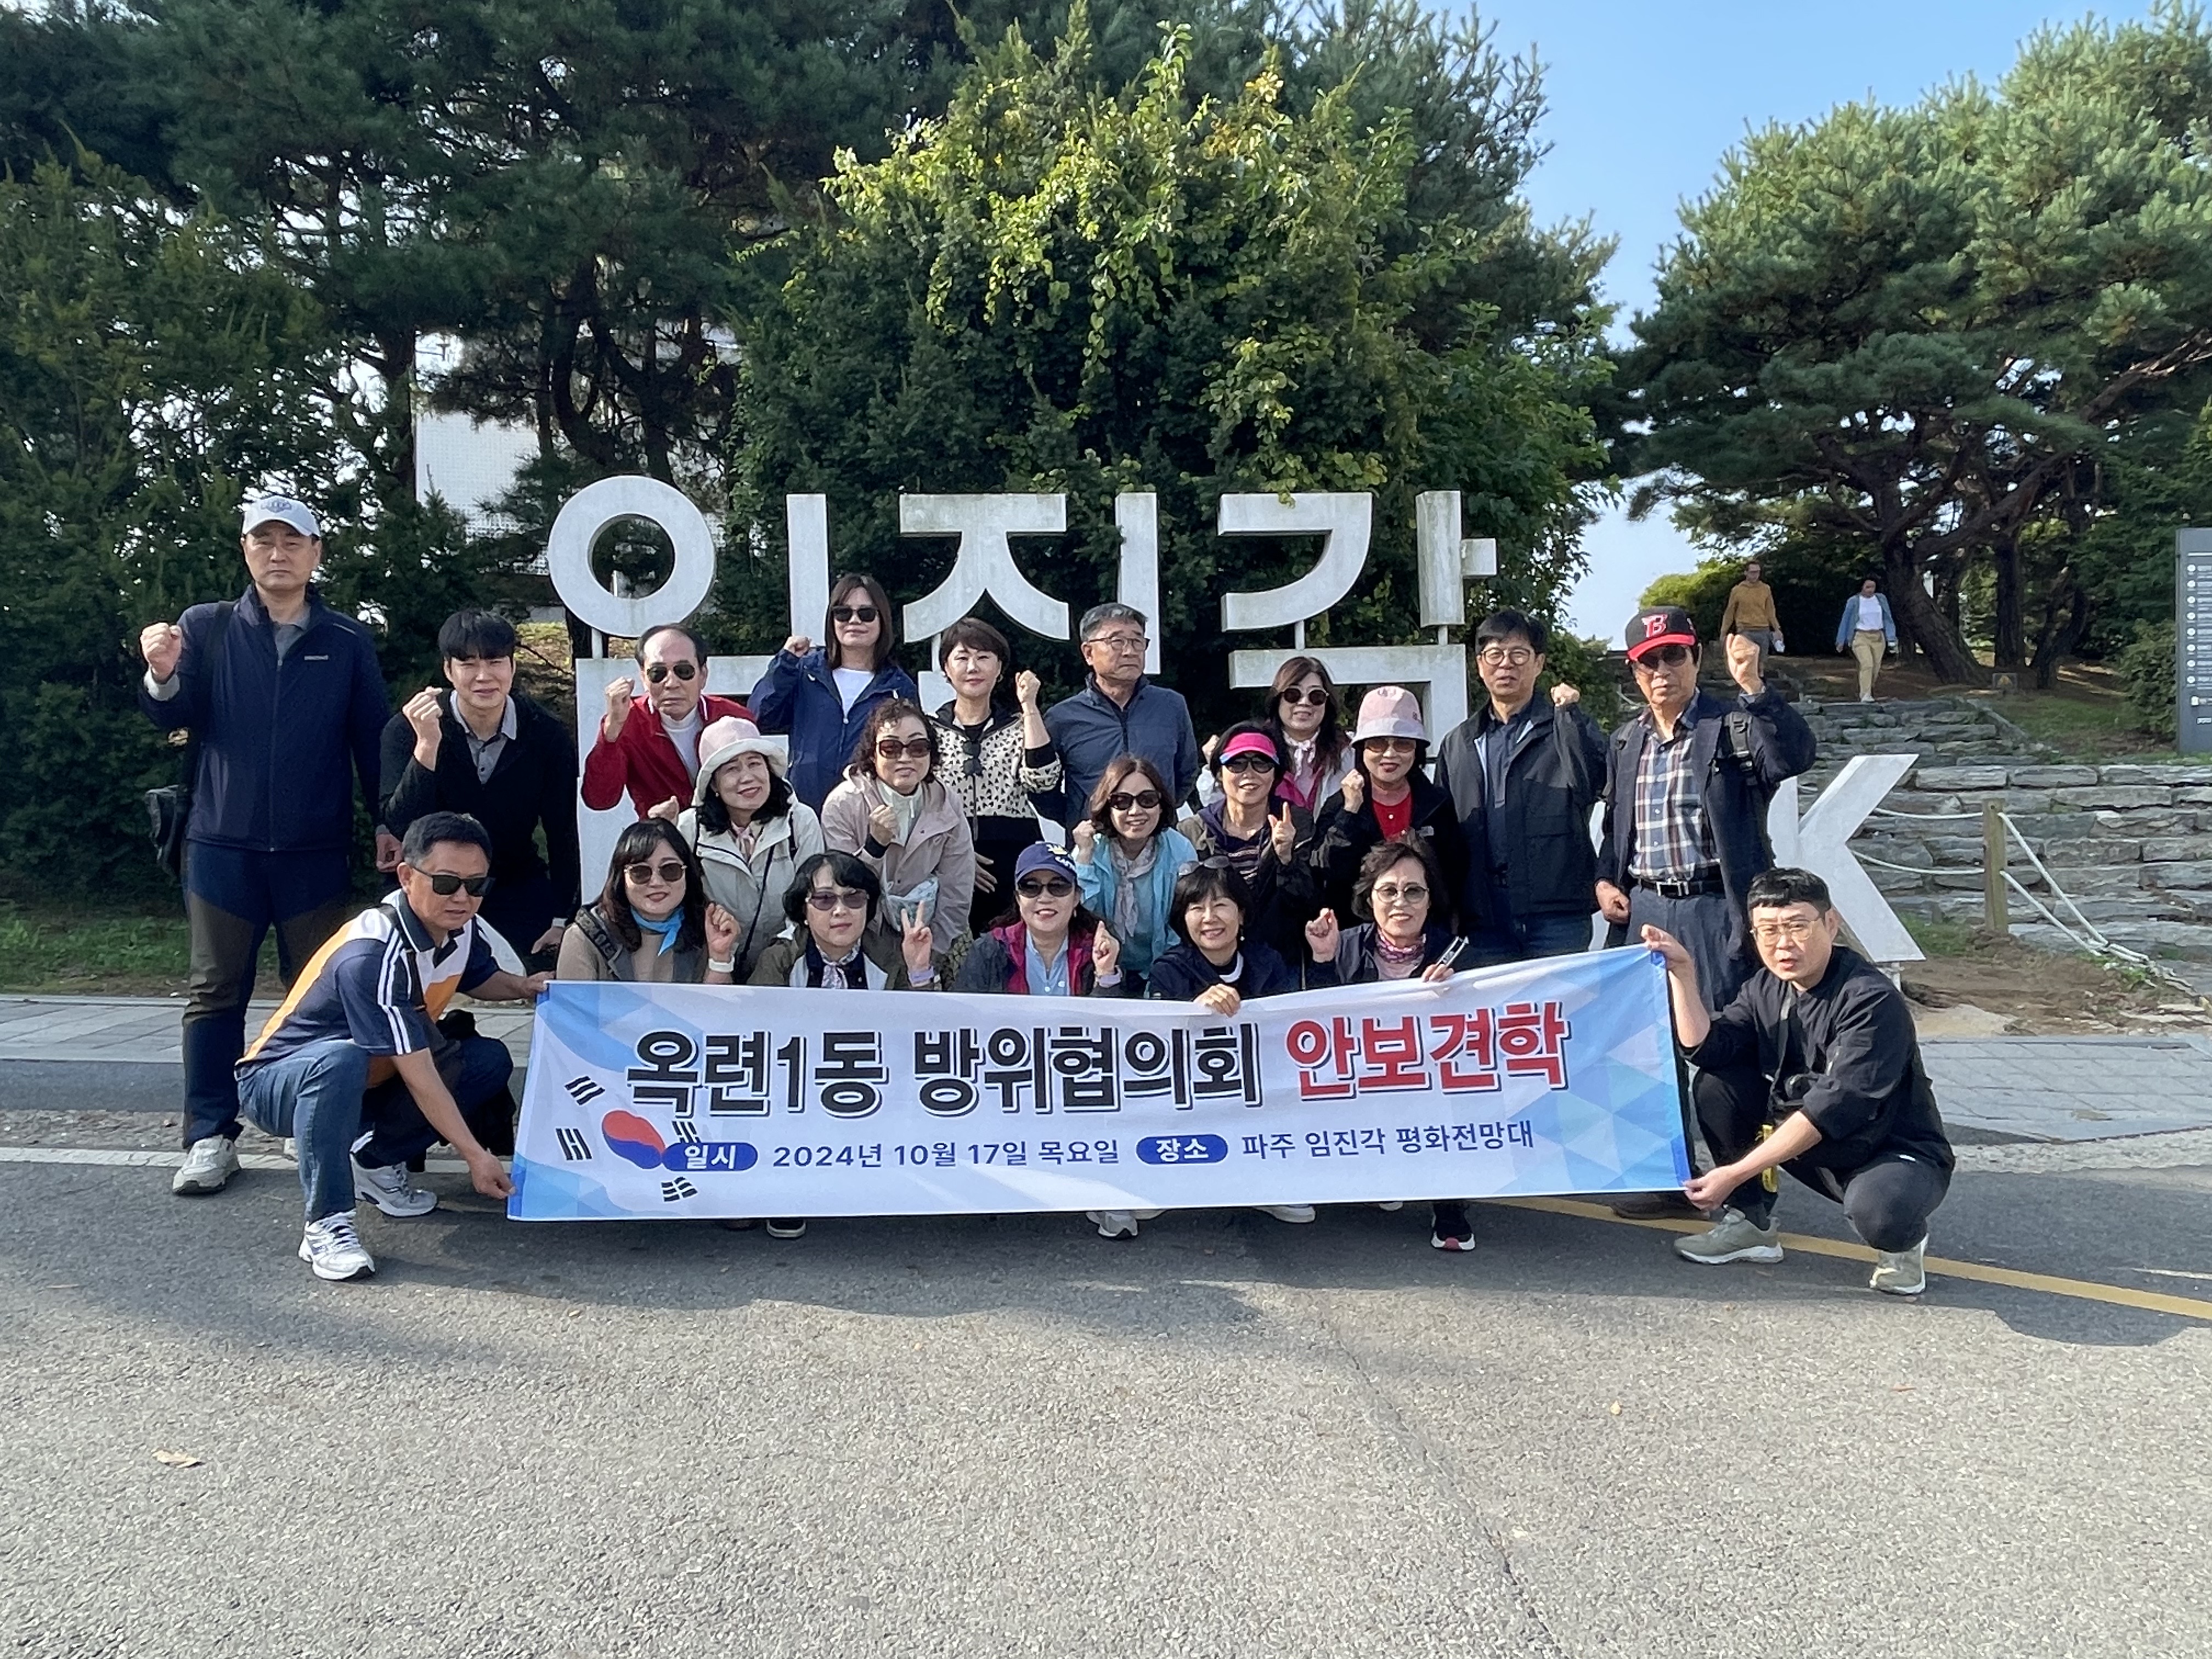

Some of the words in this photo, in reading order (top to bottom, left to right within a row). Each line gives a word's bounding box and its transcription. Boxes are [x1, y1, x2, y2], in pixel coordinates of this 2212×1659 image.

[626, 1029, 889, 1119] 옥련1동
[913, 1023, 1262, 1116] 방위협의회
[1285, 1001, 1571, 1101] 안보견학
[684, 1144, 737, 1170] 일시
[773, 1143, 883, 1169] 2024년
[894, 1141, 957, 1167] 10월
[969, 1141, 1027, 1166] 17일
[1037, 1139, 1120, 1165] 목요일
[1155, 1138, 1210, 1161] 장소
[1242, 1133, 1296, 1160] 파주
[1305, 1129, 1386, 1158] 임진각
[1396, 1120, 1535, 1154] 평화전망대
